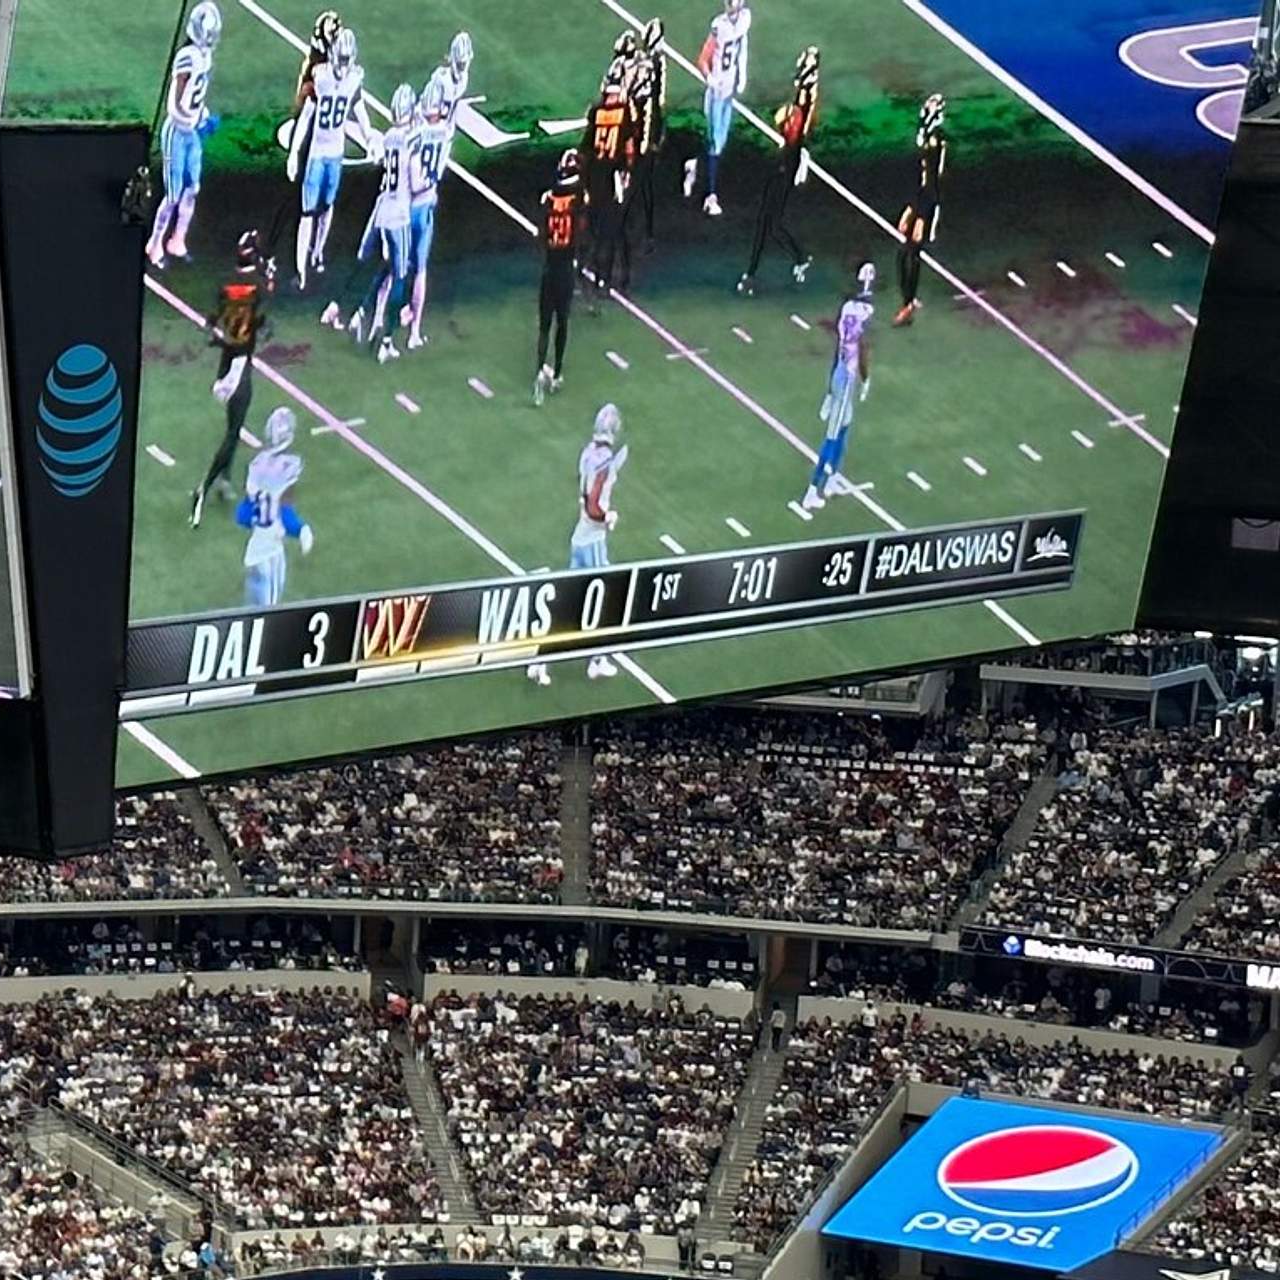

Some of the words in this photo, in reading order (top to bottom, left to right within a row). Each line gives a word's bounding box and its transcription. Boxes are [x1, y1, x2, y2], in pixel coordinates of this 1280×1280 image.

[187, 618, 265, 684] DAL
[303, 612, 331, 669] 3
[478, 583, 556, 645] WAS
[581, 578, 605, 632] 0
[728, 557, 778, 604] 7:01
[875, 530, 1014, 581] #DALVSWAS
[902, 1211, 1059, 1249] pepsi
